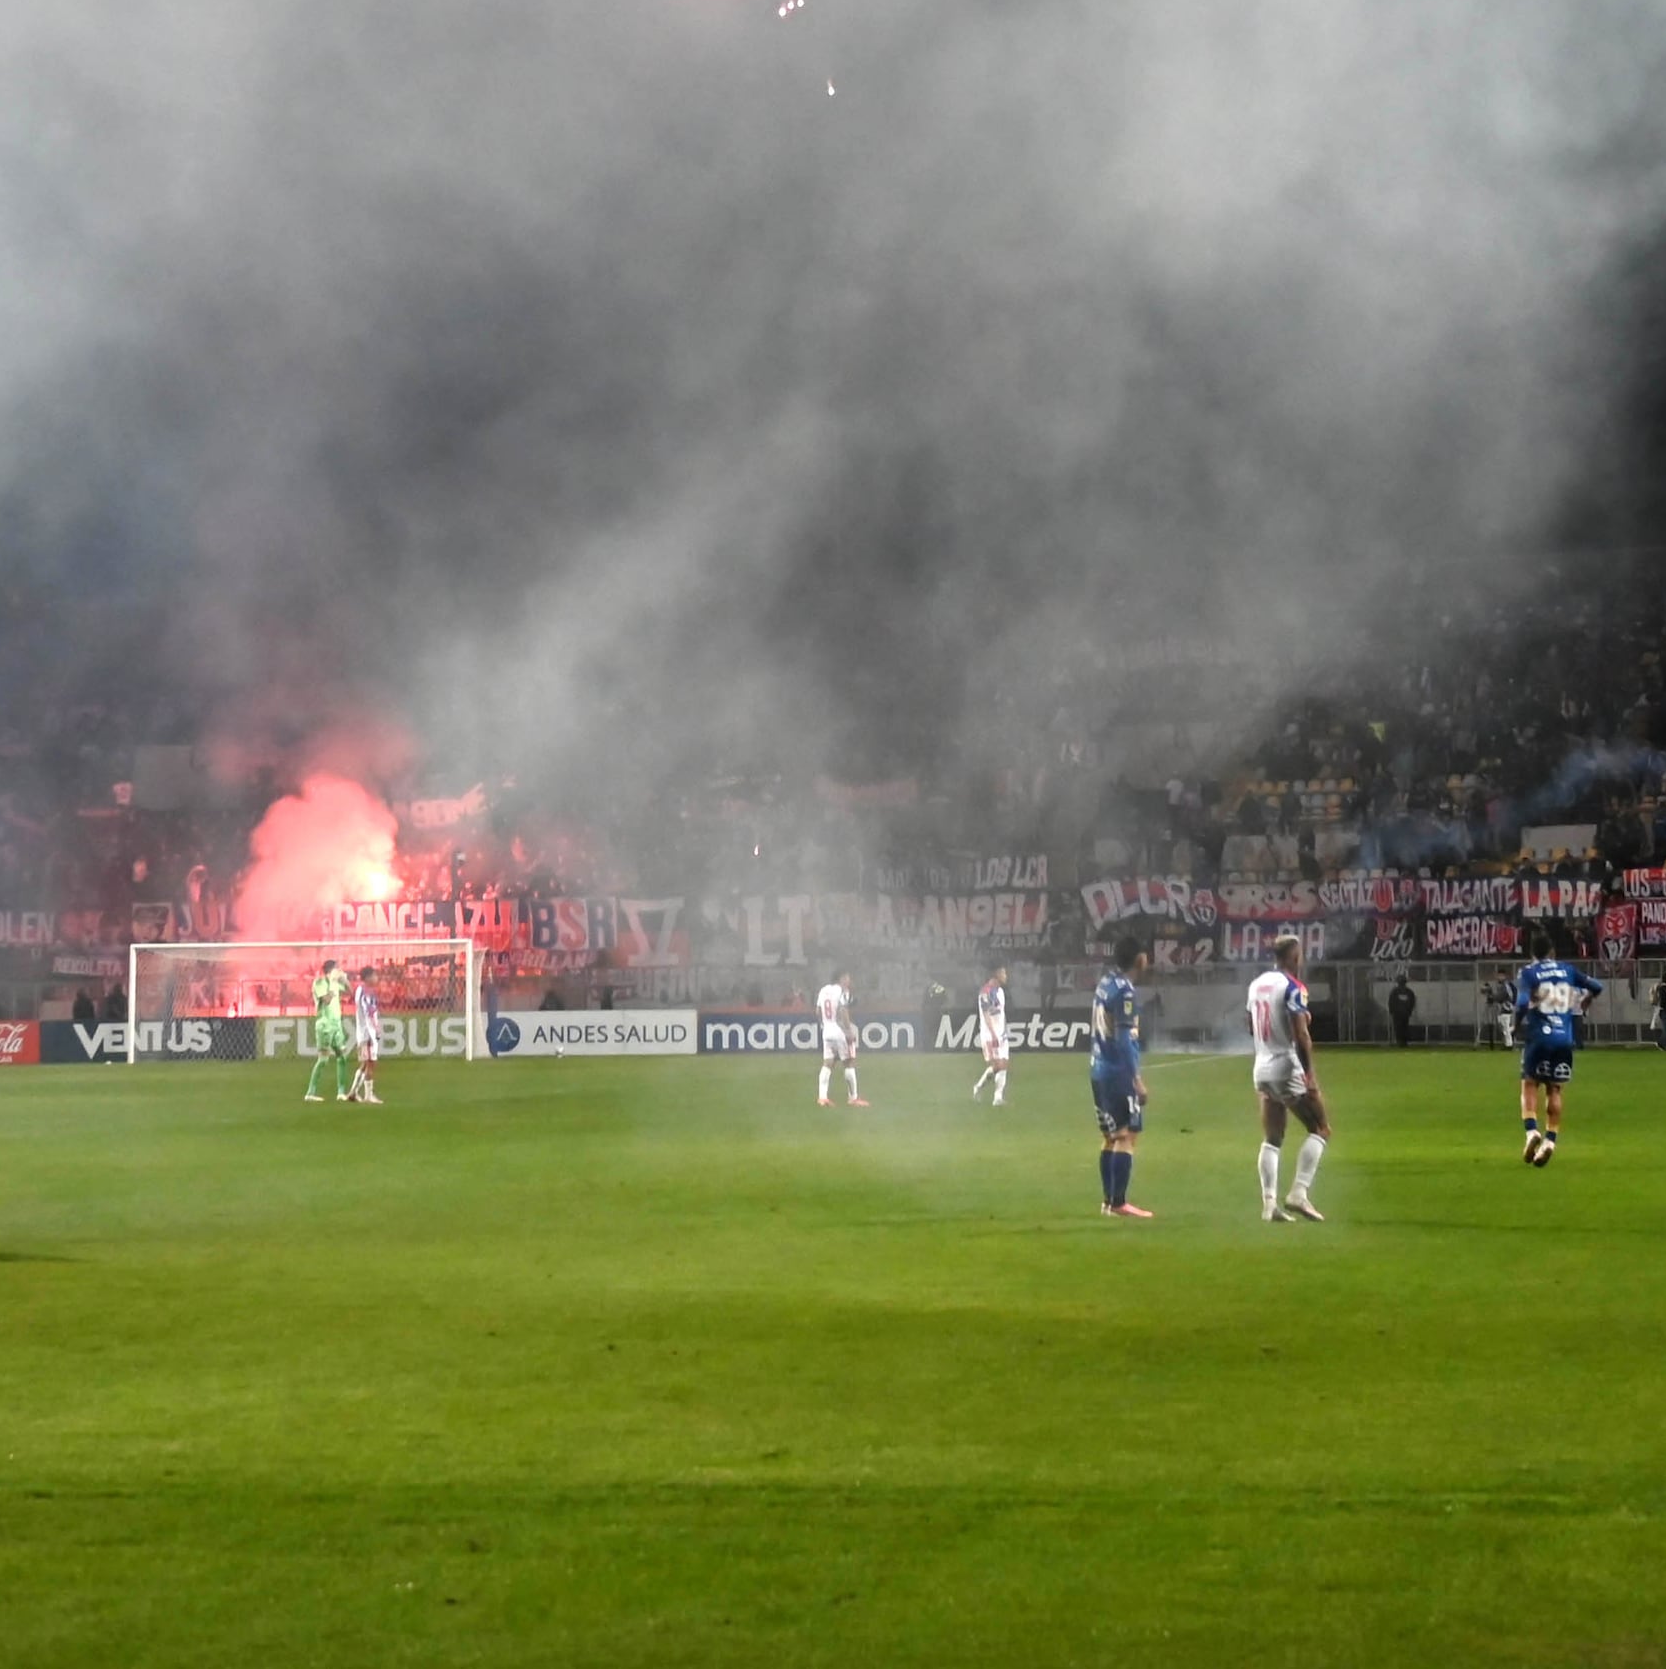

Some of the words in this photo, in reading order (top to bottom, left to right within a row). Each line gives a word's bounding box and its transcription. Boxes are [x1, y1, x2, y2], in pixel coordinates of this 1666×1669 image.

[1422, 878, 1519, 914] TALAGANTE
[1522, 880, 1553, 918] LA
[533, 1024, 608, 1045] ANDES
[614, 1023, 687, 1044] SALUD
